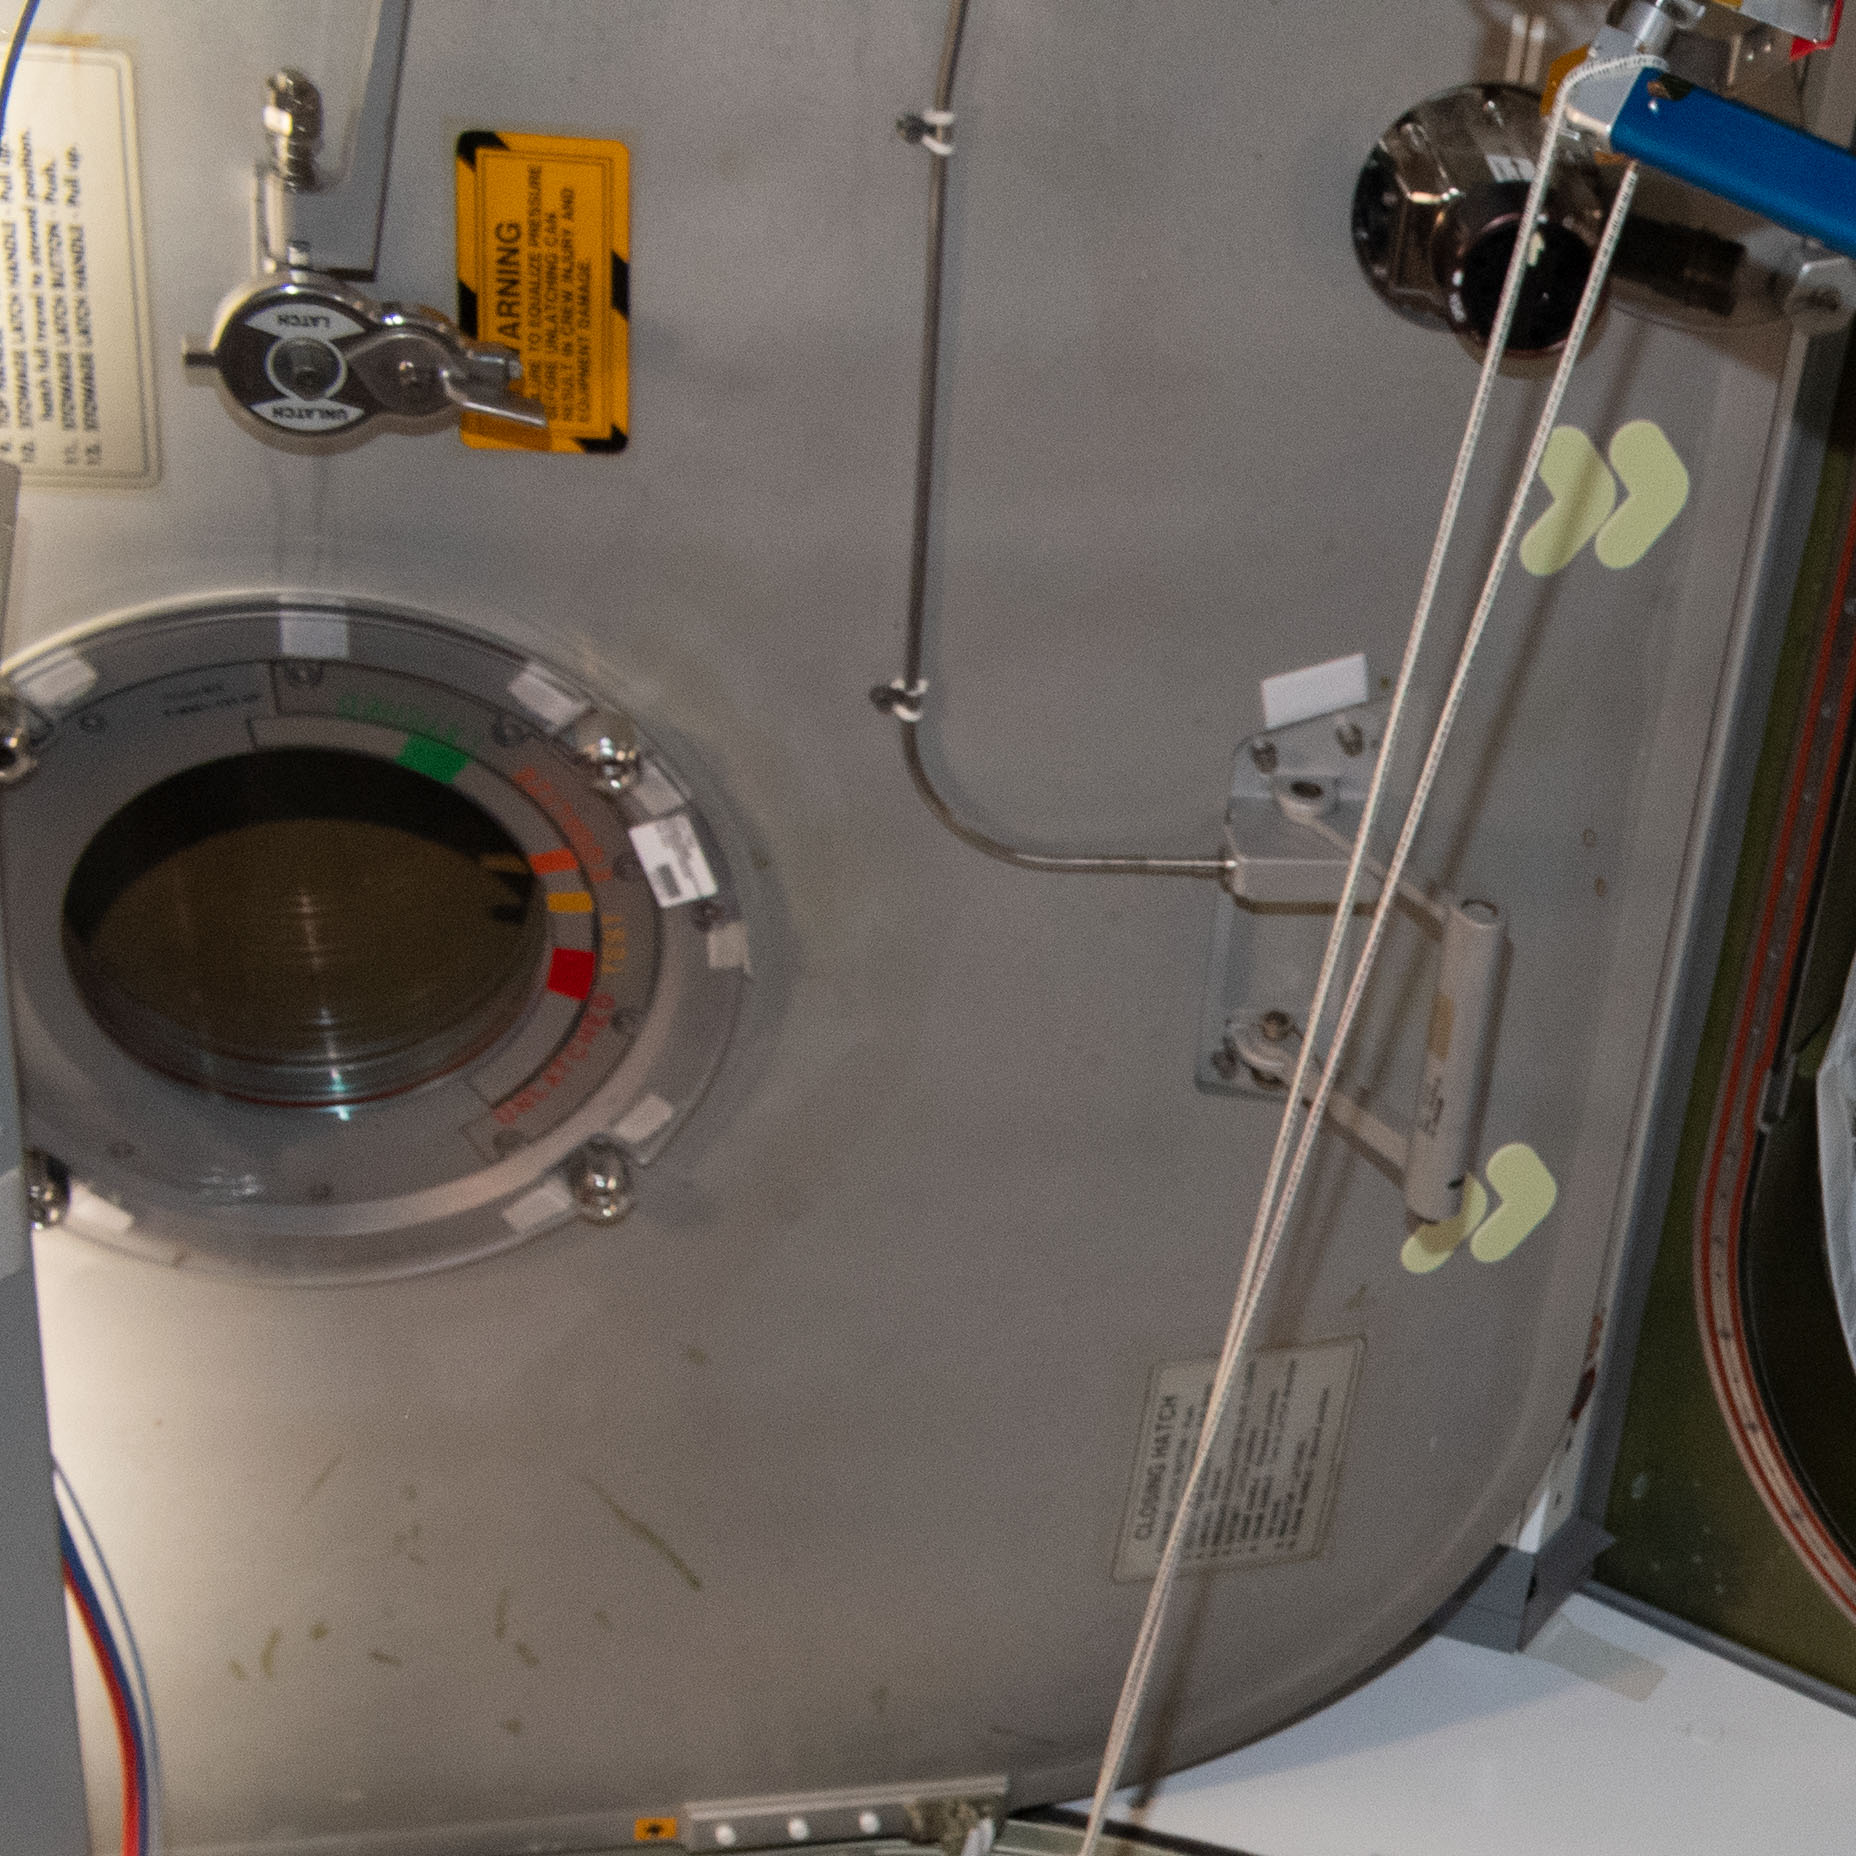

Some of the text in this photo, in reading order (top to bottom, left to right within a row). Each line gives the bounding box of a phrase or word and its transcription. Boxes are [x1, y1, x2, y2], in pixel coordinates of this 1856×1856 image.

[561, 188, 573, 221] AND
[528, 165, 541, 350] TO EQUALIZE PRESSURE
[561, 228, 573, 282] INJURY
[496, 221, 520, 354] ARNING
[544, 212, 557, 419] BEFORE UNLATCHING CAN
[561, 289, 573, 335] CREW
[278, 315, 330, 327] LATCH
[561, 364, 573, 420] RESULT
[577, 336, 589, 423] EQUIPMENT
[271, 407, 347, 419] UNLATCH
[1134, 1394, 1177, 1541] CLOSING HATCH
